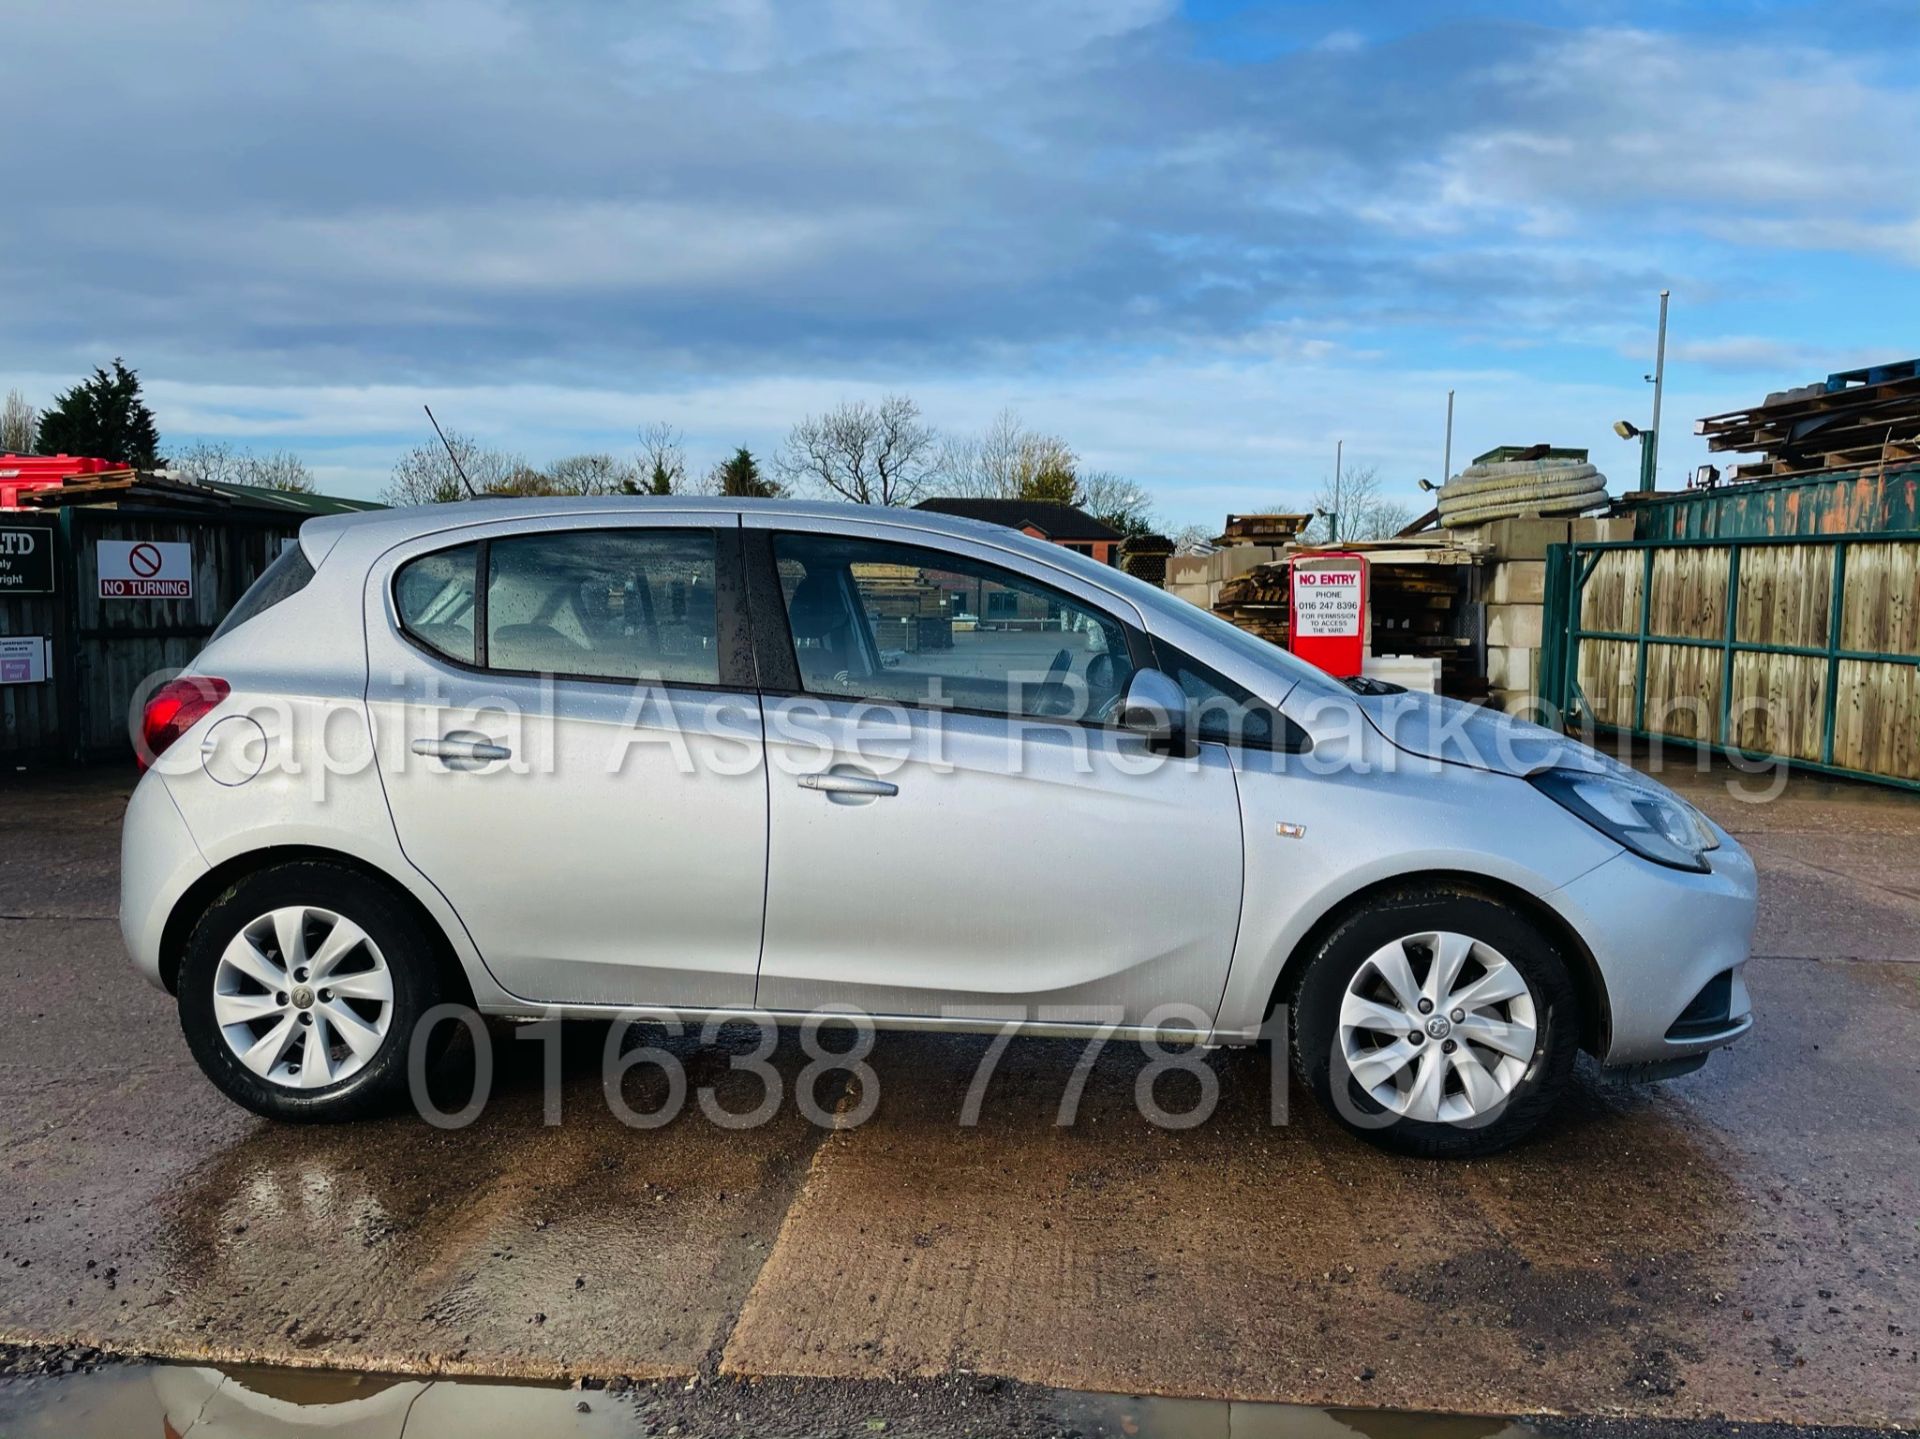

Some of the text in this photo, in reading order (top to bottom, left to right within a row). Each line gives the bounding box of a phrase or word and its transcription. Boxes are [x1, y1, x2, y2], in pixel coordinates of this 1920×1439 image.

[0, 532, 35, 555] TD
[1299, 574, 1356, 585] NO ENTRY
[104, 581, 188, 595] NO TURNING
[1315, 591, 1342, 599] PHONE
[1299, 602, 1358, 610] 0116 247 8396
